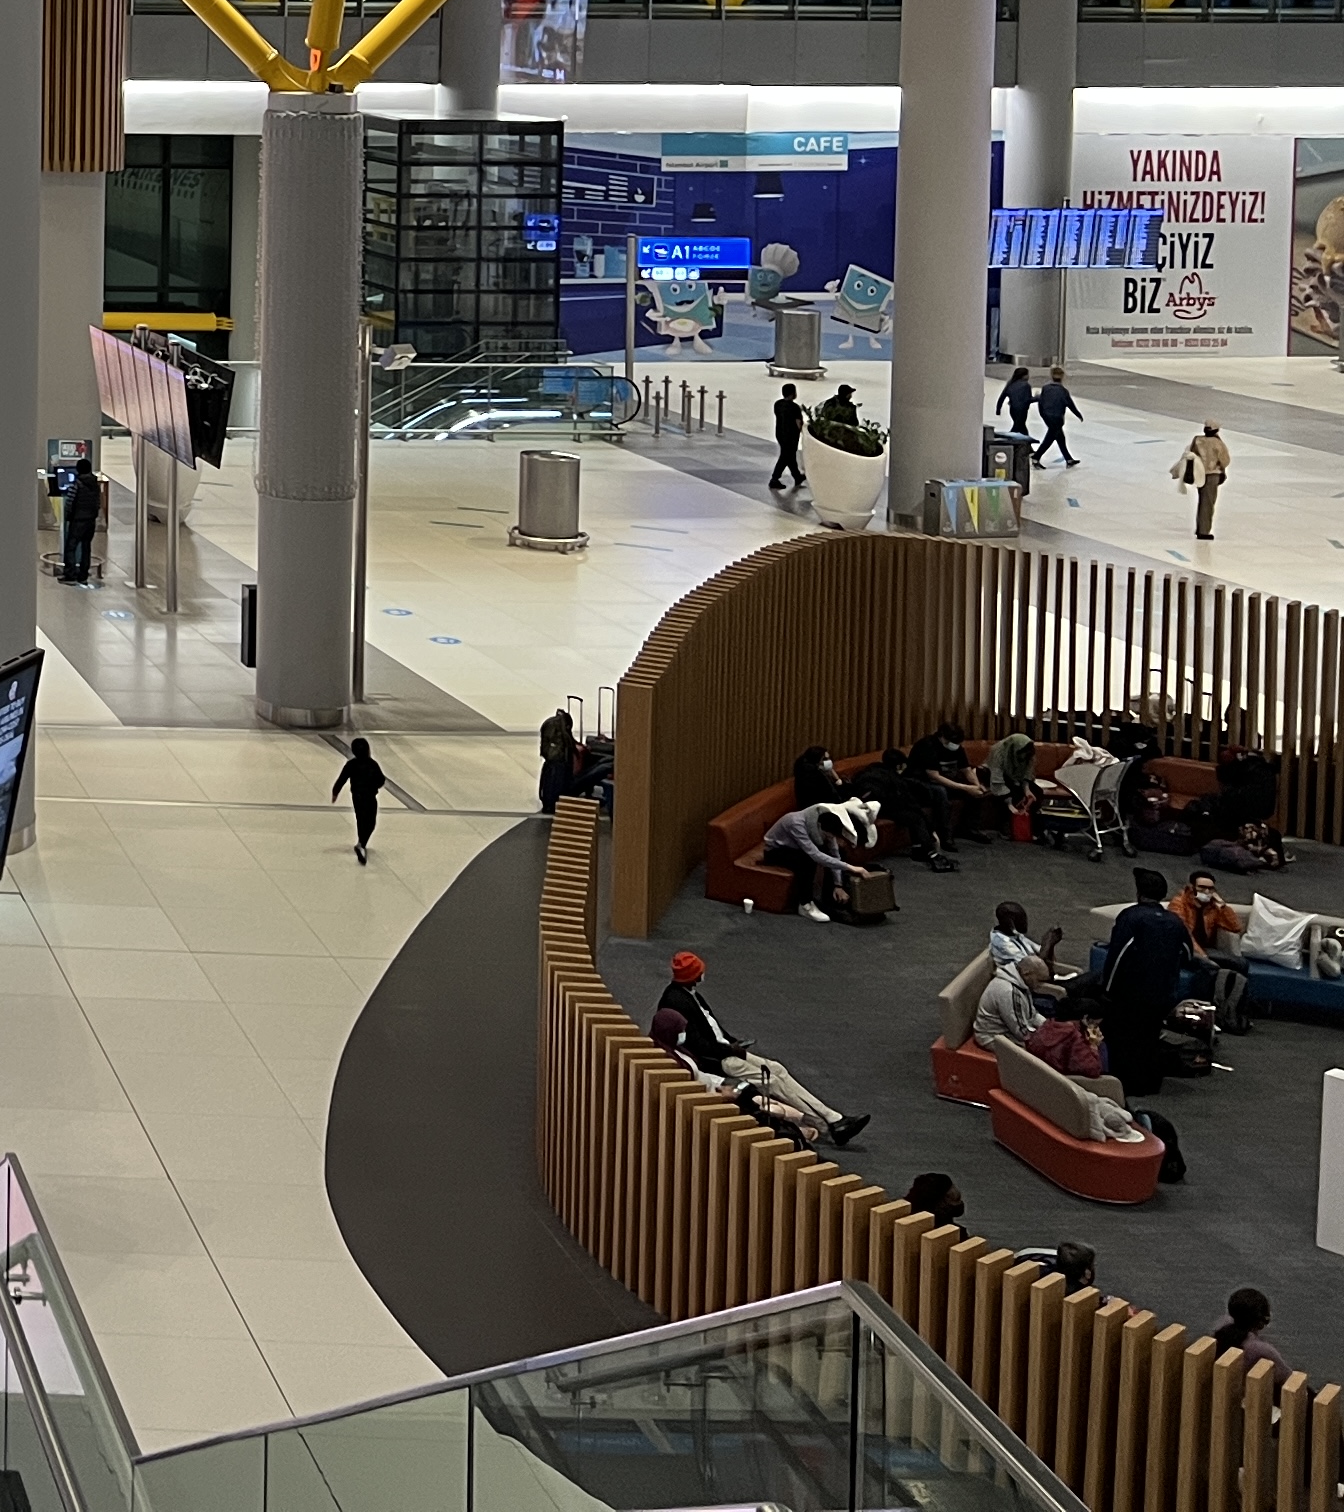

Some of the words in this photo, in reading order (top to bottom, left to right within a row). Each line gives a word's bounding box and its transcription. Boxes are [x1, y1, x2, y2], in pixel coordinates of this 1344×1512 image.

[793, 137, 844, 152] CAFE
[1129, 150, 1222, 182] YAKINDA
[672, 245, 690, 259] A1
